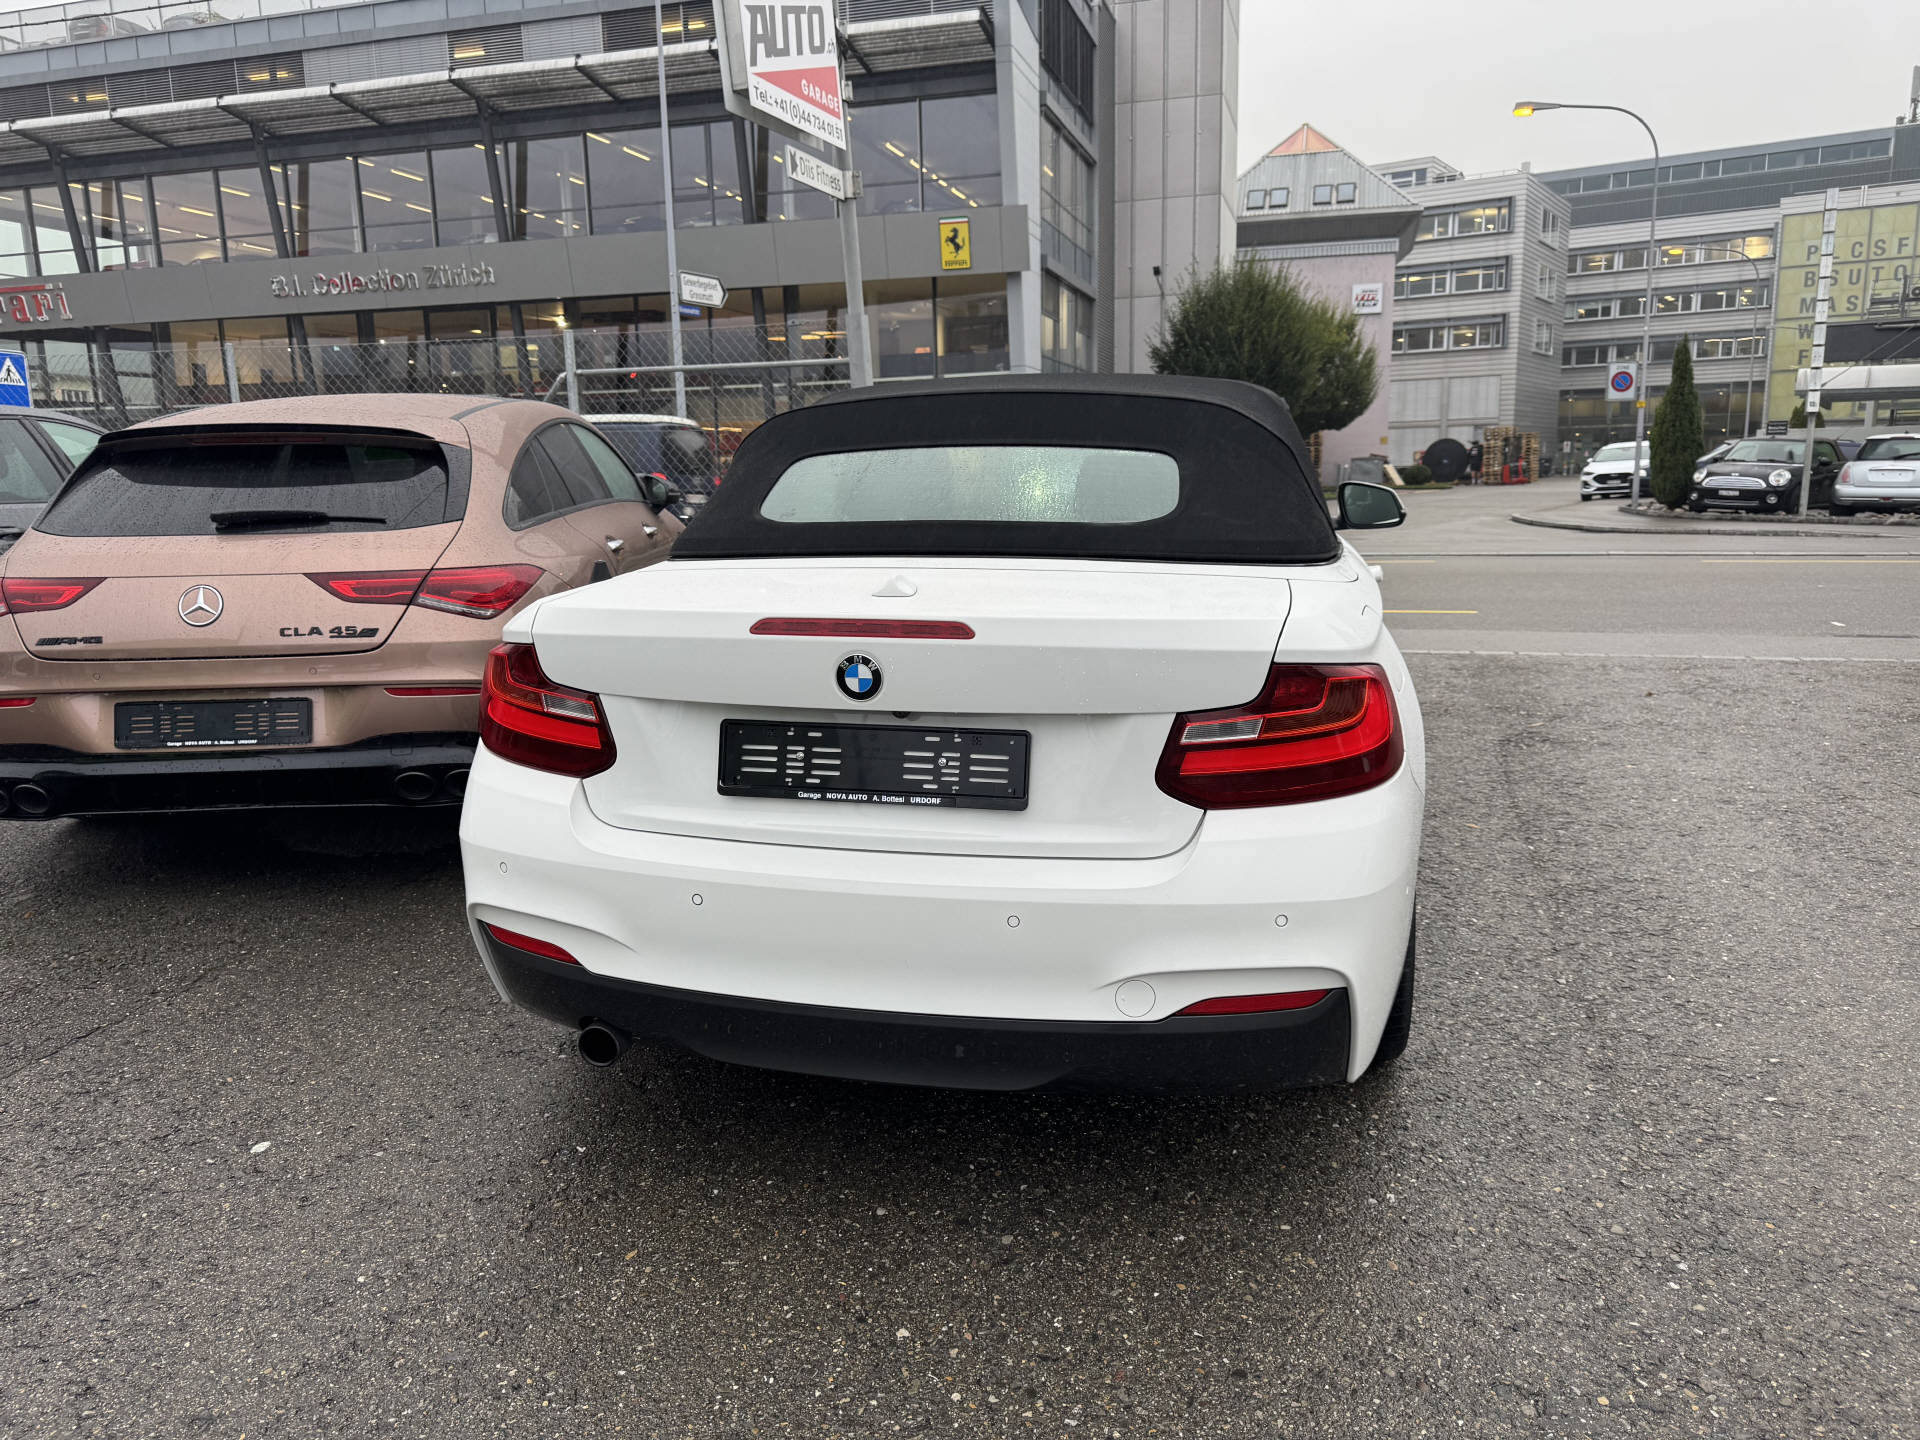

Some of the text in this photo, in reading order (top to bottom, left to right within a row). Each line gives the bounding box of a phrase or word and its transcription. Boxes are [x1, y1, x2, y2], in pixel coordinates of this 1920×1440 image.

[801, 79, 840, 112] GARAGE
[774, 97, 789, 115] +41
[312, 268, 420, 296] Collection
[422, 261, 496, 290] Zürich
[279, 626, 323, 637] CLA
[54, 636, 103, 646] AMG
[839, 655, 878, 672] BMW
[797, 791, 822, 800] Garage
[826, 792, 847, 800] NOVA
[847, 793, 868, 801] AUTO
[872, 794, 880, 802] A.
[909, 796, 942, 805] URDORF
